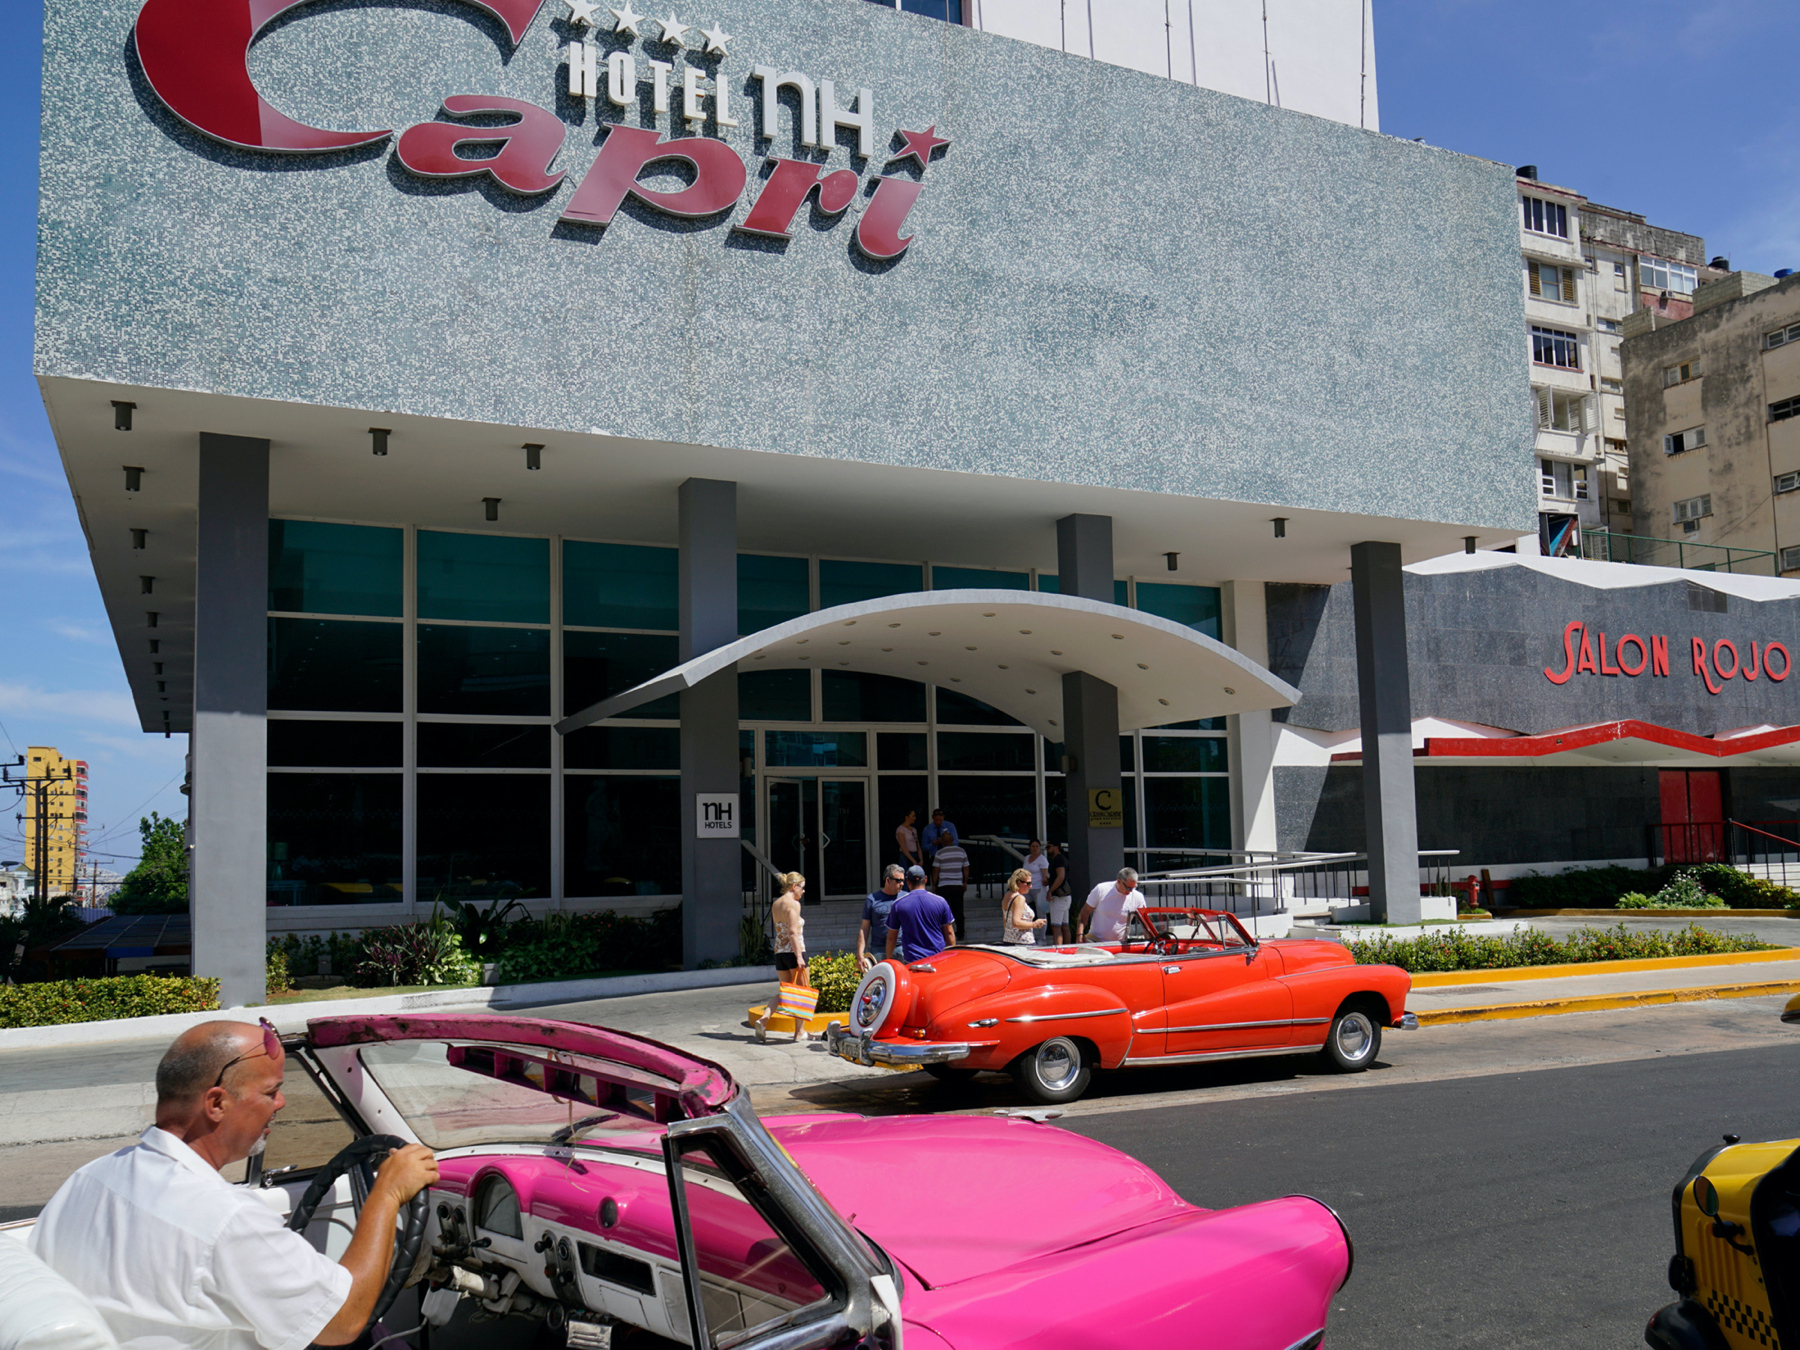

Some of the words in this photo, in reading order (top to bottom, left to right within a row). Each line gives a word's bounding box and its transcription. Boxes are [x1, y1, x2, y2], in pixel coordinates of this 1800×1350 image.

[568, 41, 738, 127] HOTEL
[133, 0, 950, 260] Capri
[1544, 621, 1669, 685] SALON
[1692, 636, 1792, 694] ROJO
[704, 821, 732, 829] HOTELS
[1095, 790, 1111, 810] C
